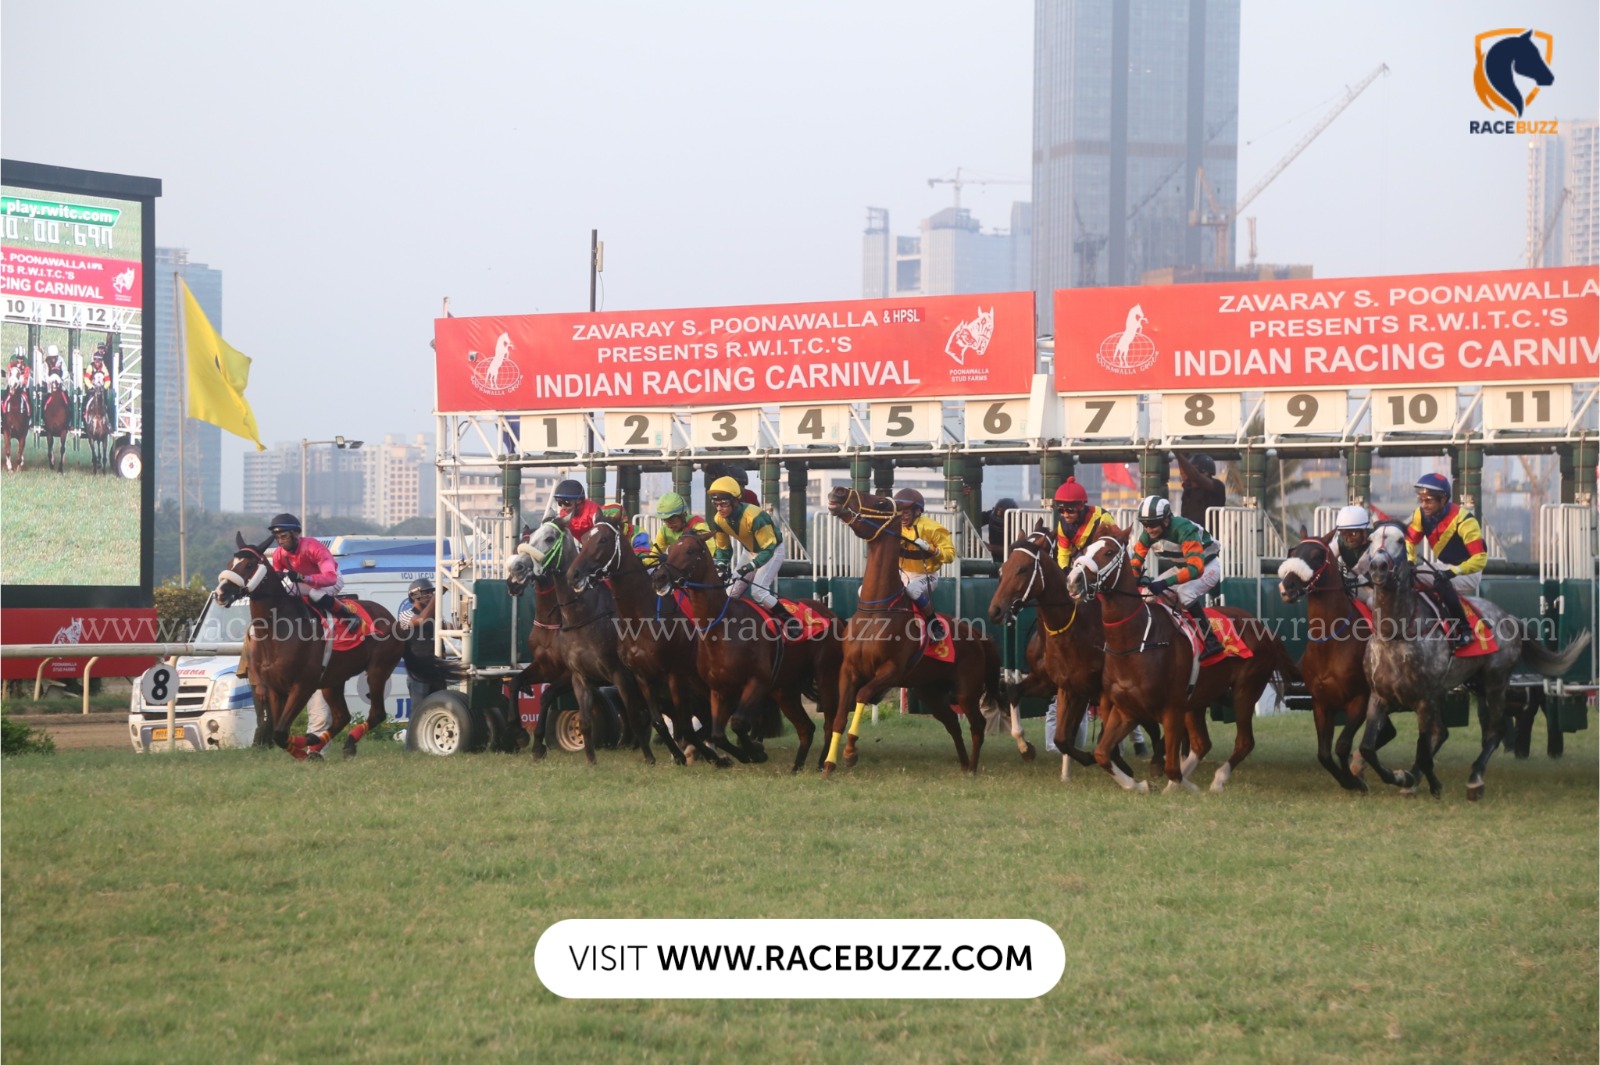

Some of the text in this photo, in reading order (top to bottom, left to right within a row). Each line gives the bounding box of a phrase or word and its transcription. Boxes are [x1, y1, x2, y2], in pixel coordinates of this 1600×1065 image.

[7, 200, 112, 223] play.rwitc.com
[10, 253, 86, 269] POONAWALLA
[35, 280, 104, 299] CARNIVAL
[1219, 279, 1599, 312] ZAVARAY S. POONAWALLA
[7, 300, 25, 313] 10
[50, 303, 65, 318] 11
[87, 308, 106, 322] 12
[572, 309, 920, 341] ZAVARAY S. POONAWALLA & HPSL
[1250, 308, 1568, 338] PRESENTS R.W.I.T.C.'S
[598, 336, 852, 363] PRESENTS R.W.I.T.C.'S
[1174, 348, 1291, 376] INDIAN
[1305, 342, 1444, 374] RACING
[536, 360, 920, 398] INDIAN RACING CARNIVAL
[950, 368, 989, 376] POONAWALLA
[968, 374, 988, 382] FARMS
[885, 405, 915, 437] 5
[982, 402, 1012, 434] 6
[1084, 401, 1116, 433] 7
[1184, 393, 1216, 427] 8
[1286, 394, 1319, 428] 9
[1388, 393, 1438, 425] 10
[1506, 390, 1550, 423] 11
[542, 417, 558, 447] 1
[624, 415, 650, 445] 2
[711, 411, 738, 442] 3
[797, 408, 825, 440] 4
[151, 668, 170, 700] 8
